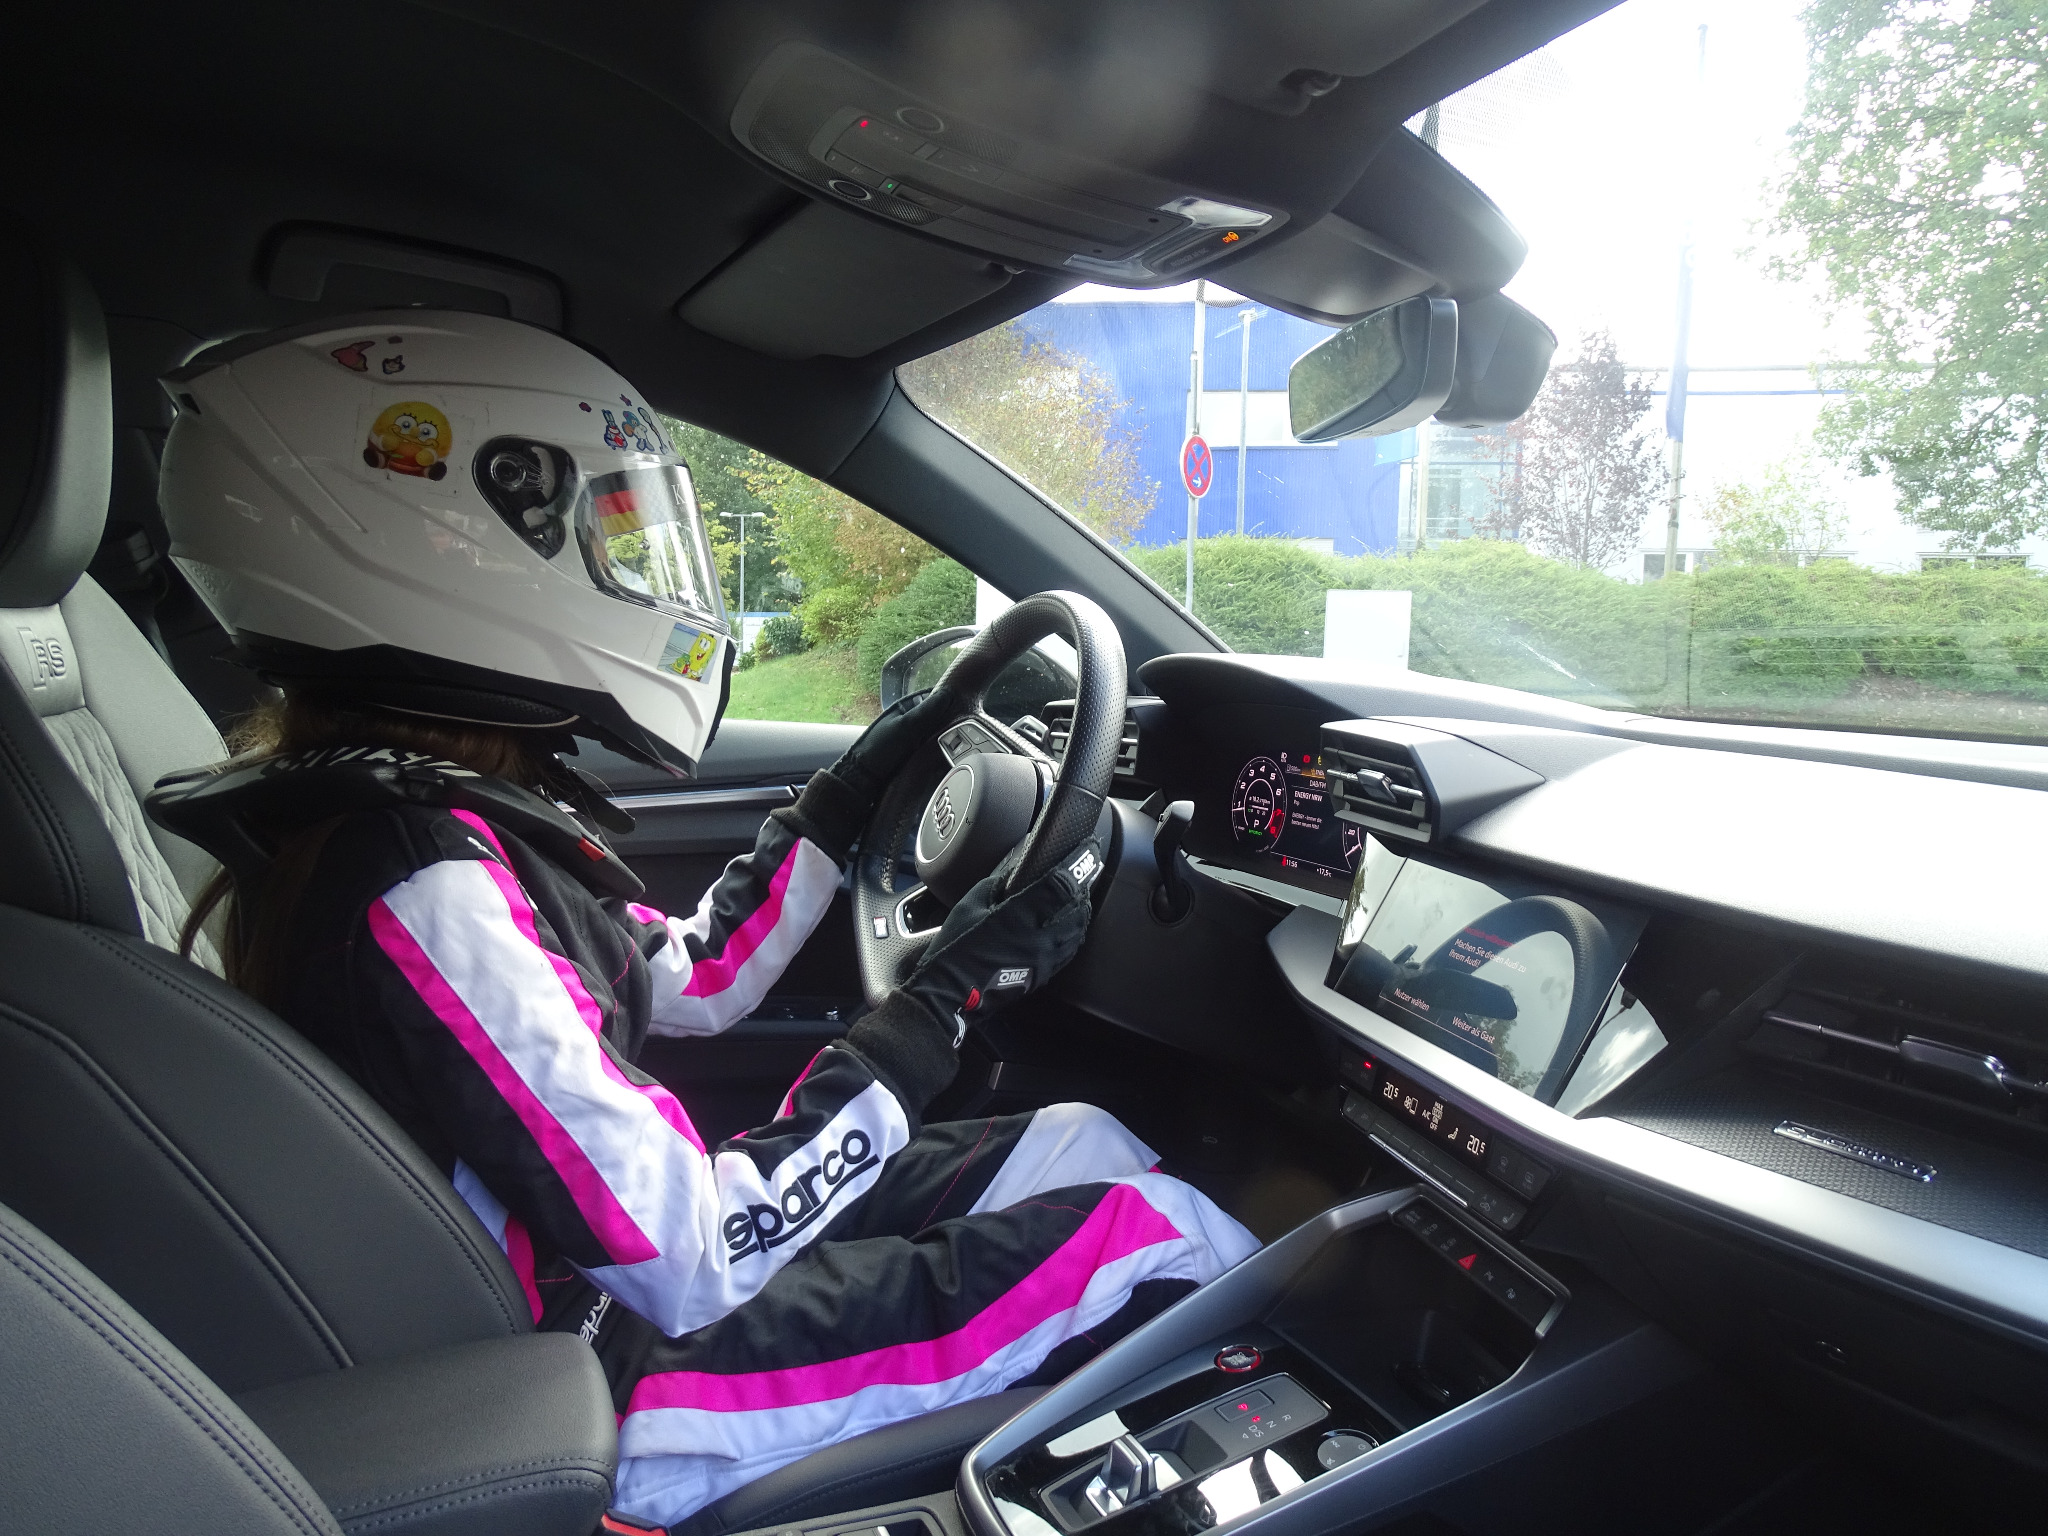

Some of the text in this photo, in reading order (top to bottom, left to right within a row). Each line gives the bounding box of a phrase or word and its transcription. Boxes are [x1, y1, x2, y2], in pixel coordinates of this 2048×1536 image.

[1248, 769, 1255, 777] 3
[1259, 765, 1266, 773] 4
[1269, 772, 1277, 780] 5
[1240, 781, 1247, 789] 2
[1294, 790, 1311, 800] ENERGY
[1253, 819, 1260, 828] P
[1072, 852, 1095, 880] OMP
[1448, 948, 1482, 968] Ihrem Audi!
[1454, 938, 1527, 973] Machen Sie diesen Audi zu
[999, 970, 1029, 983] OMP
[1393, 987, 1430, 1012] Nutzer wählen
[1452, 1015, 1496, 1043] Weiter als Gast
[723, 1128, 873, 1254] sparco
